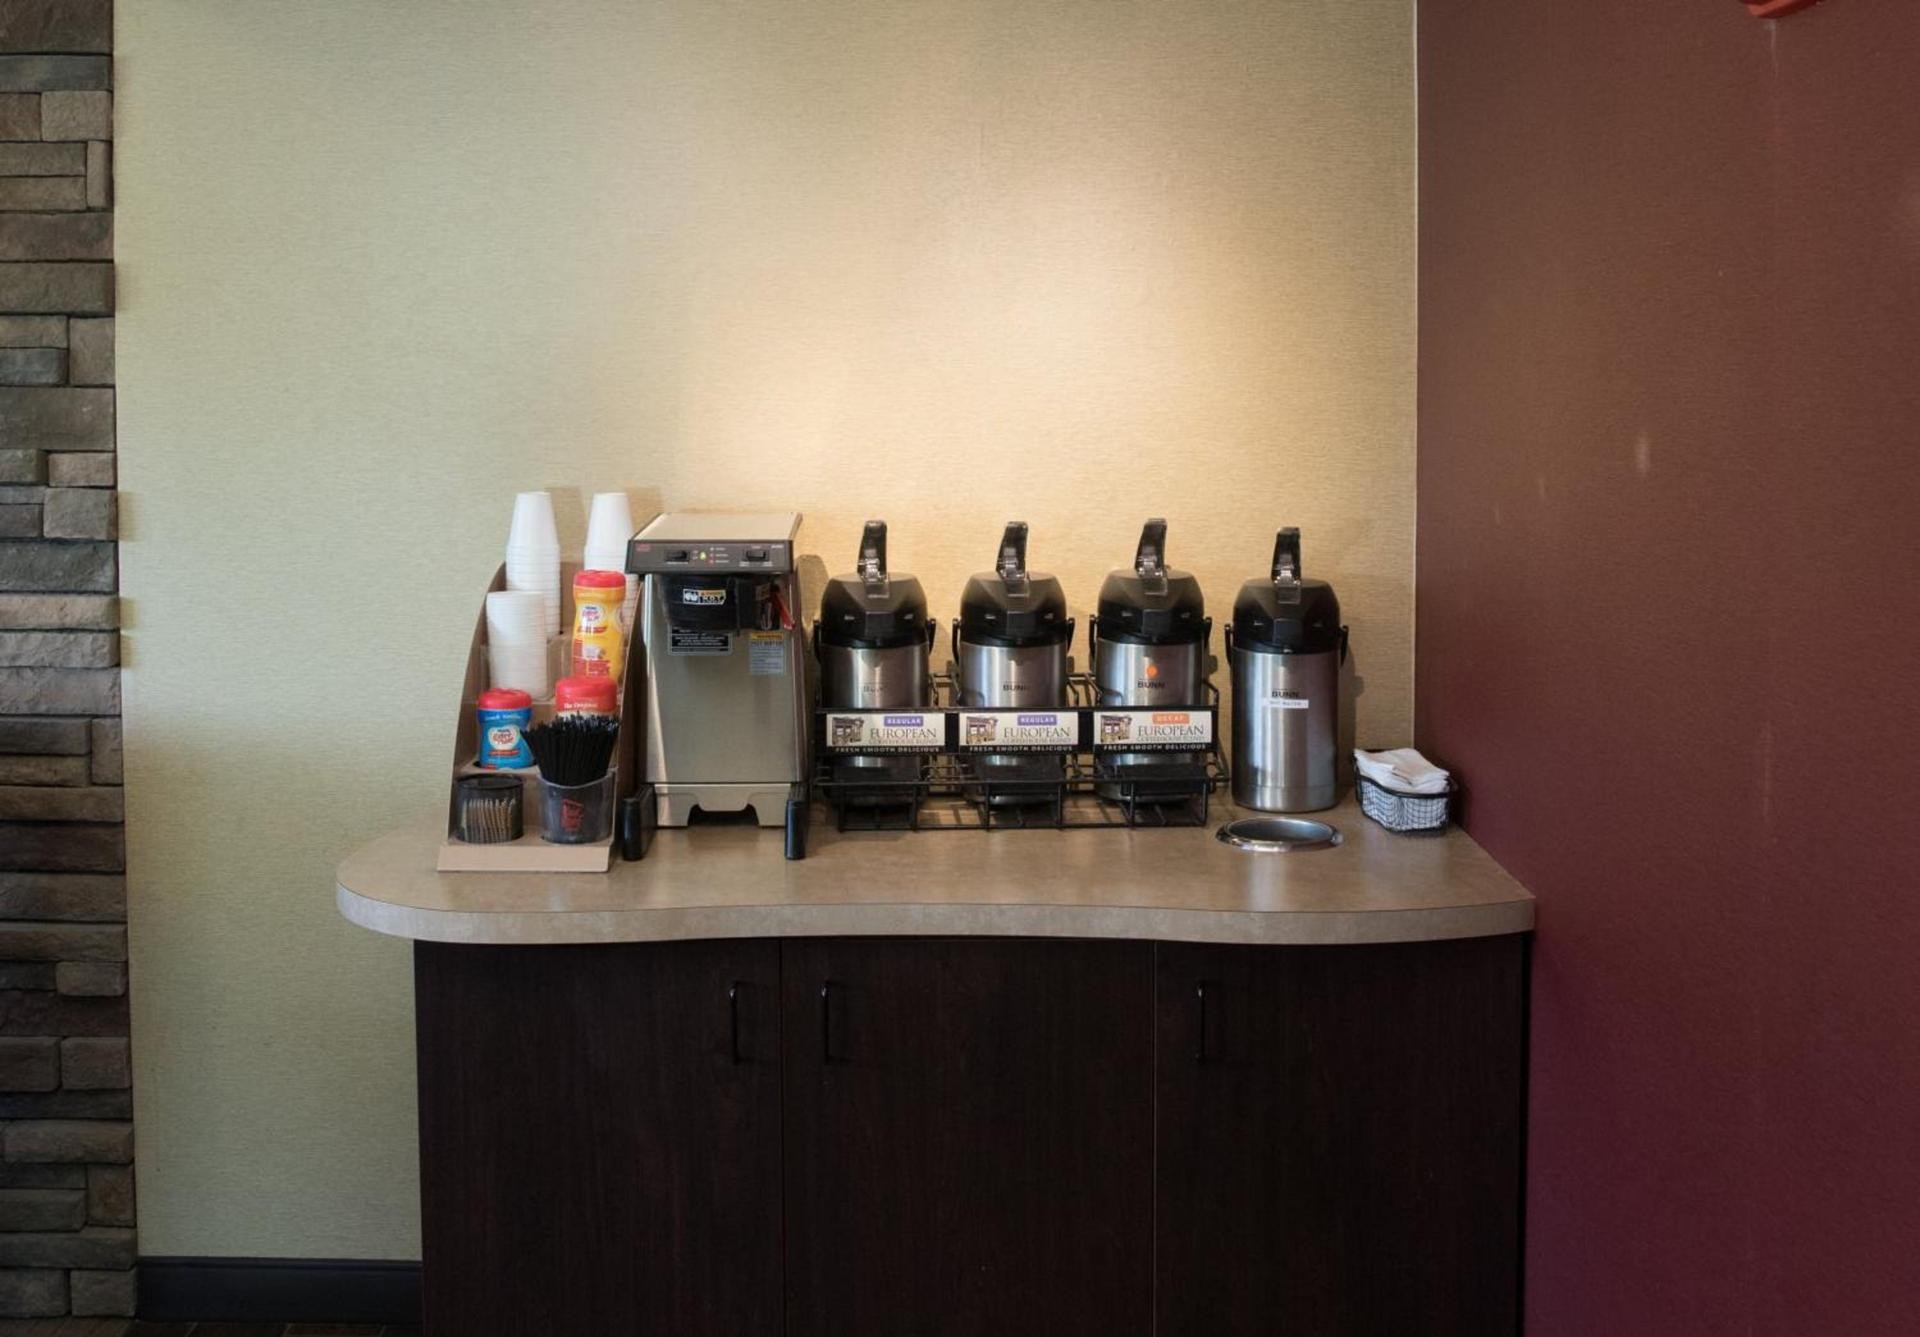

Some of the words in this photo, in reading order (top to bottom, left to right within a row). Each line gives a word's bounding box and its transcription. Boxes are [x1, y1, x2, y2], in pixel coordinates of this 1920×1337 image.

[870, 728, 937, 739] EUROPEAN
[1004, 727, 1071, 738] EUROPEAN
[1138, 724, 1204, 736] EUROPEAN
